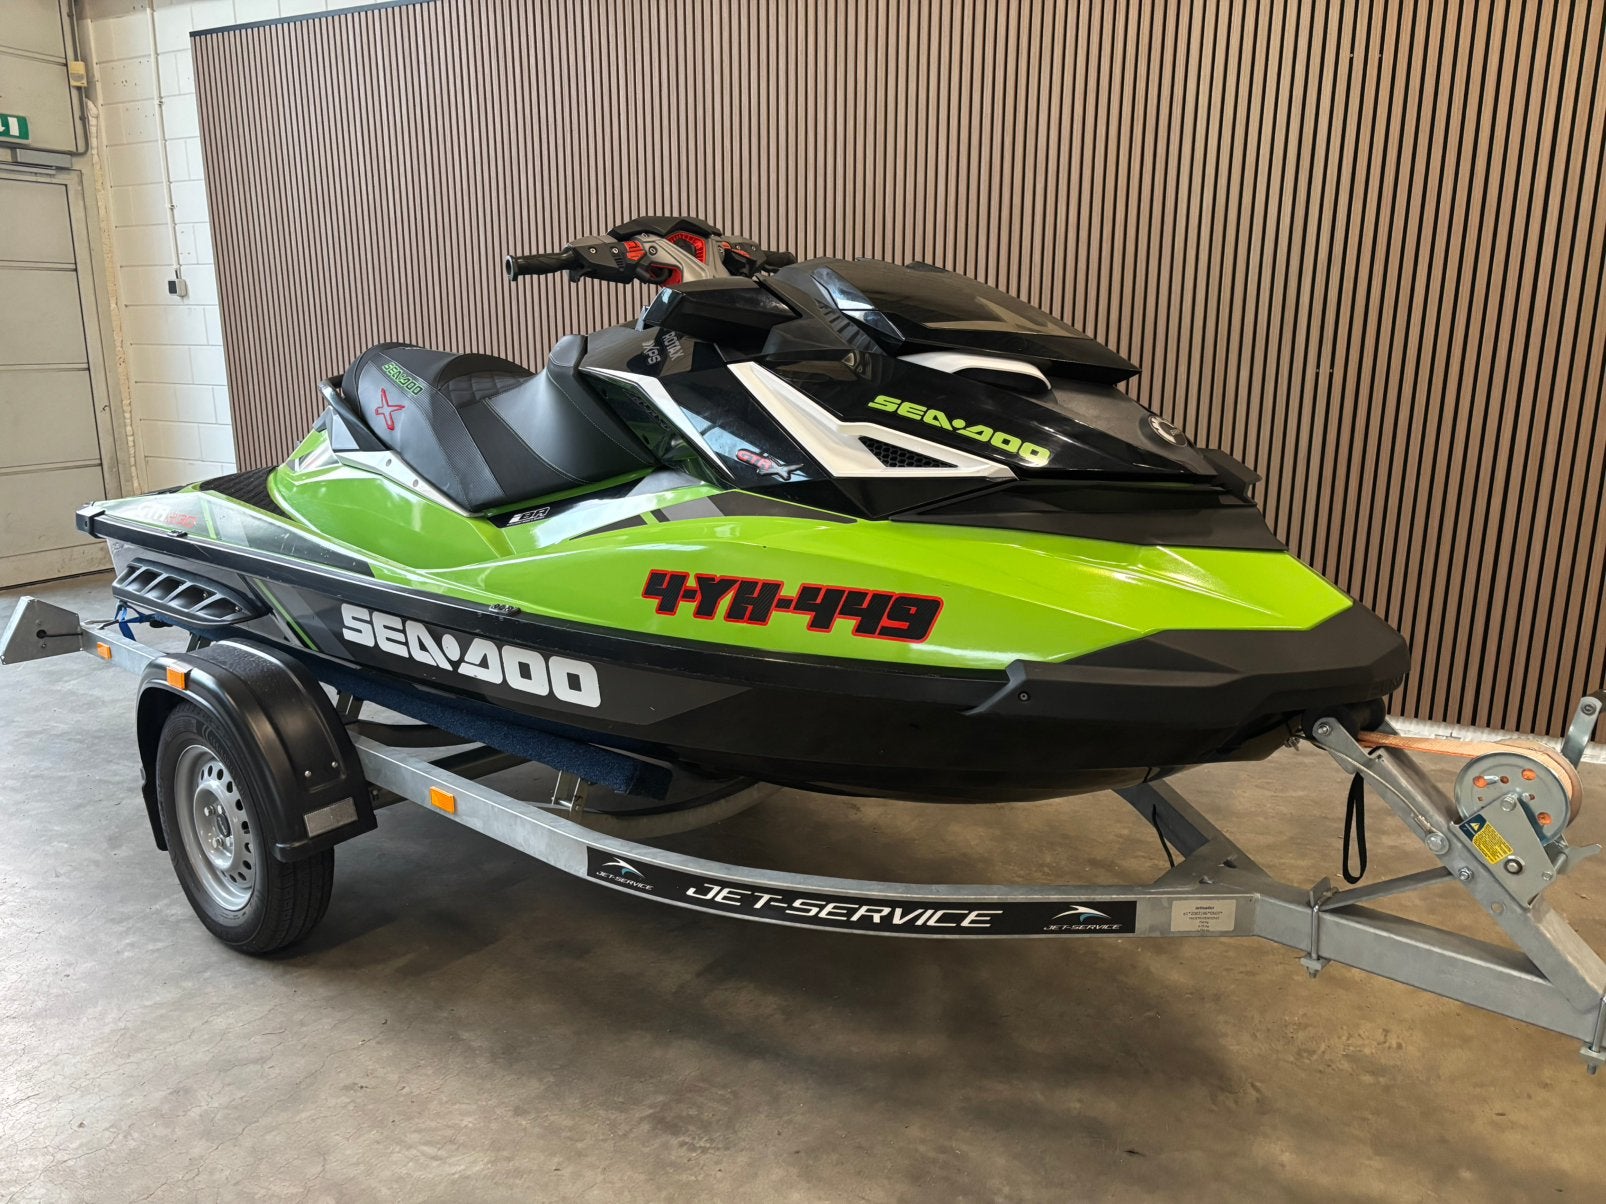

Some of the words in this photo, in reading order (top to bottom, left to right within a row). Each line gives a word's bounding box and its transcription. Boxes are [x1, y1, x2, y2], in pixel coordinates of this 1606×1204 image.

[662, 331, 684, 361] ROTAX
[641, 568, 944, 643] 4-YH-449
[596, 871, 655, 892] JET-SERVICE
[686, 883, 1004, 928] JET-SERVICE
